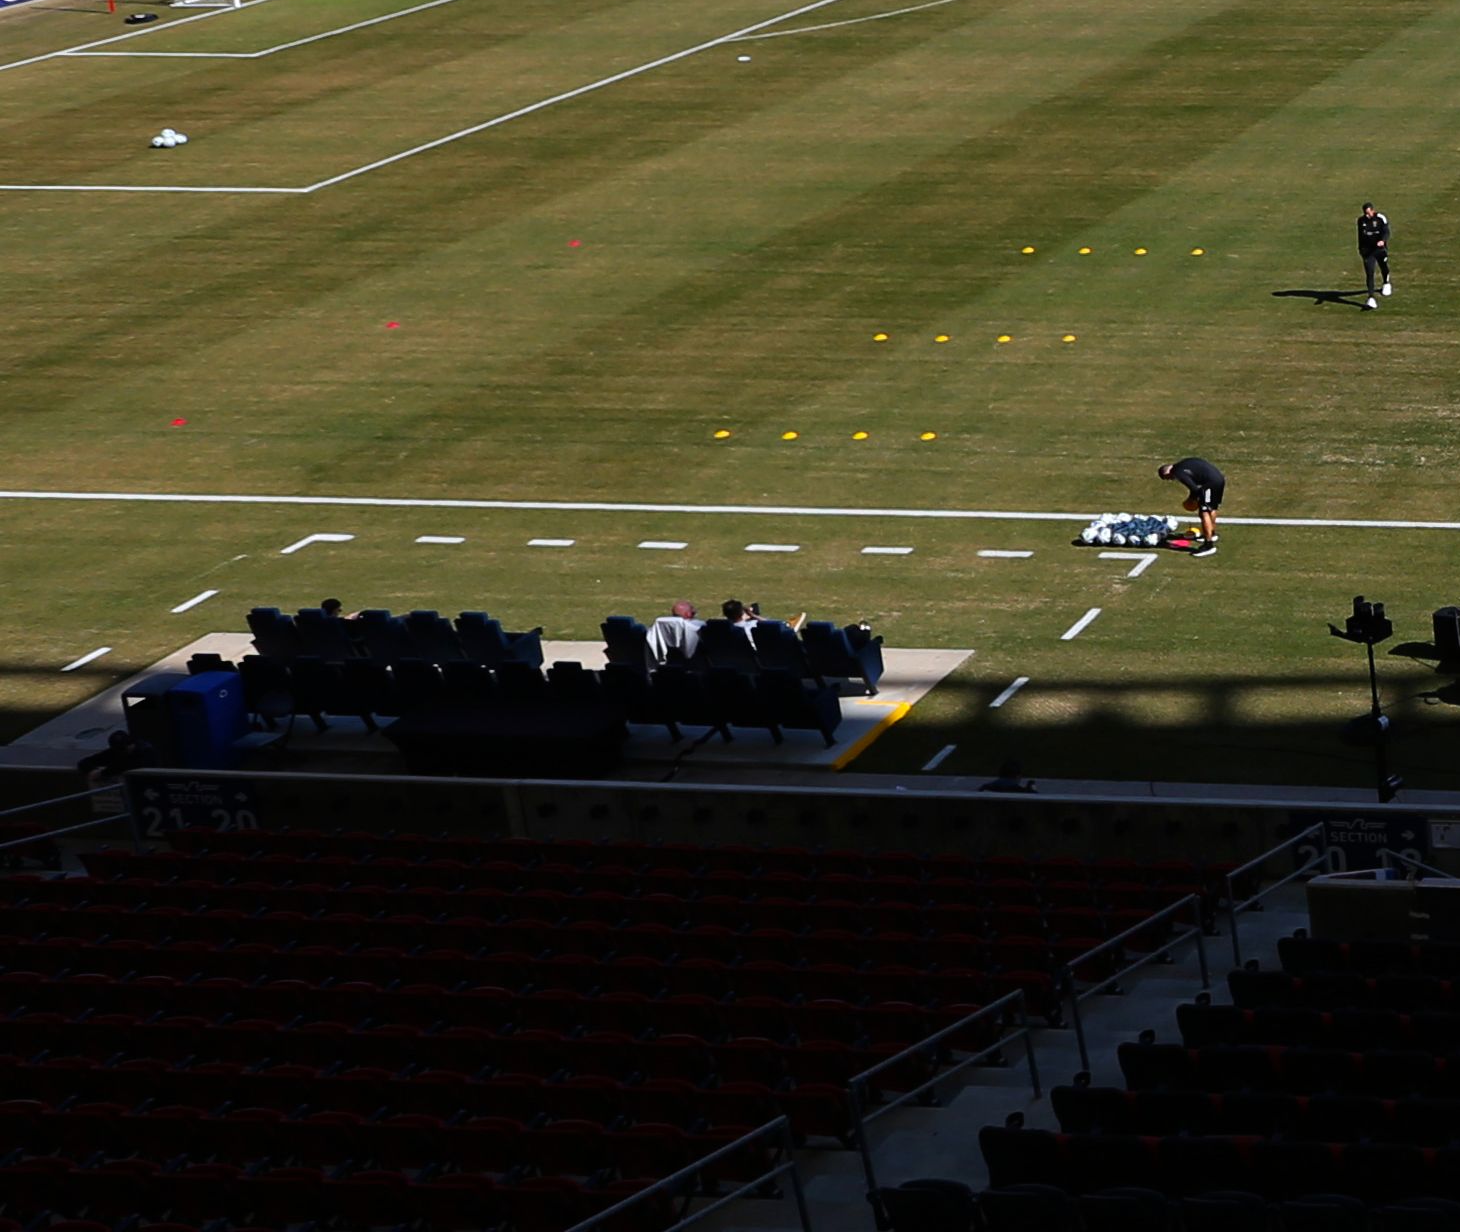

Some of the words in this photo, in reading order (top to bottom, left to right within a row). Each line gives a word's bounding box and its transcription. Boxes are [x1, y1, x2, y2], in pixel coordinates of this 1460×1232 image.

[168, 793, 223, 805] SECTION
[1330, 831, 1388, 844] SECTION
[1296, 845, 1347, 875] 20
